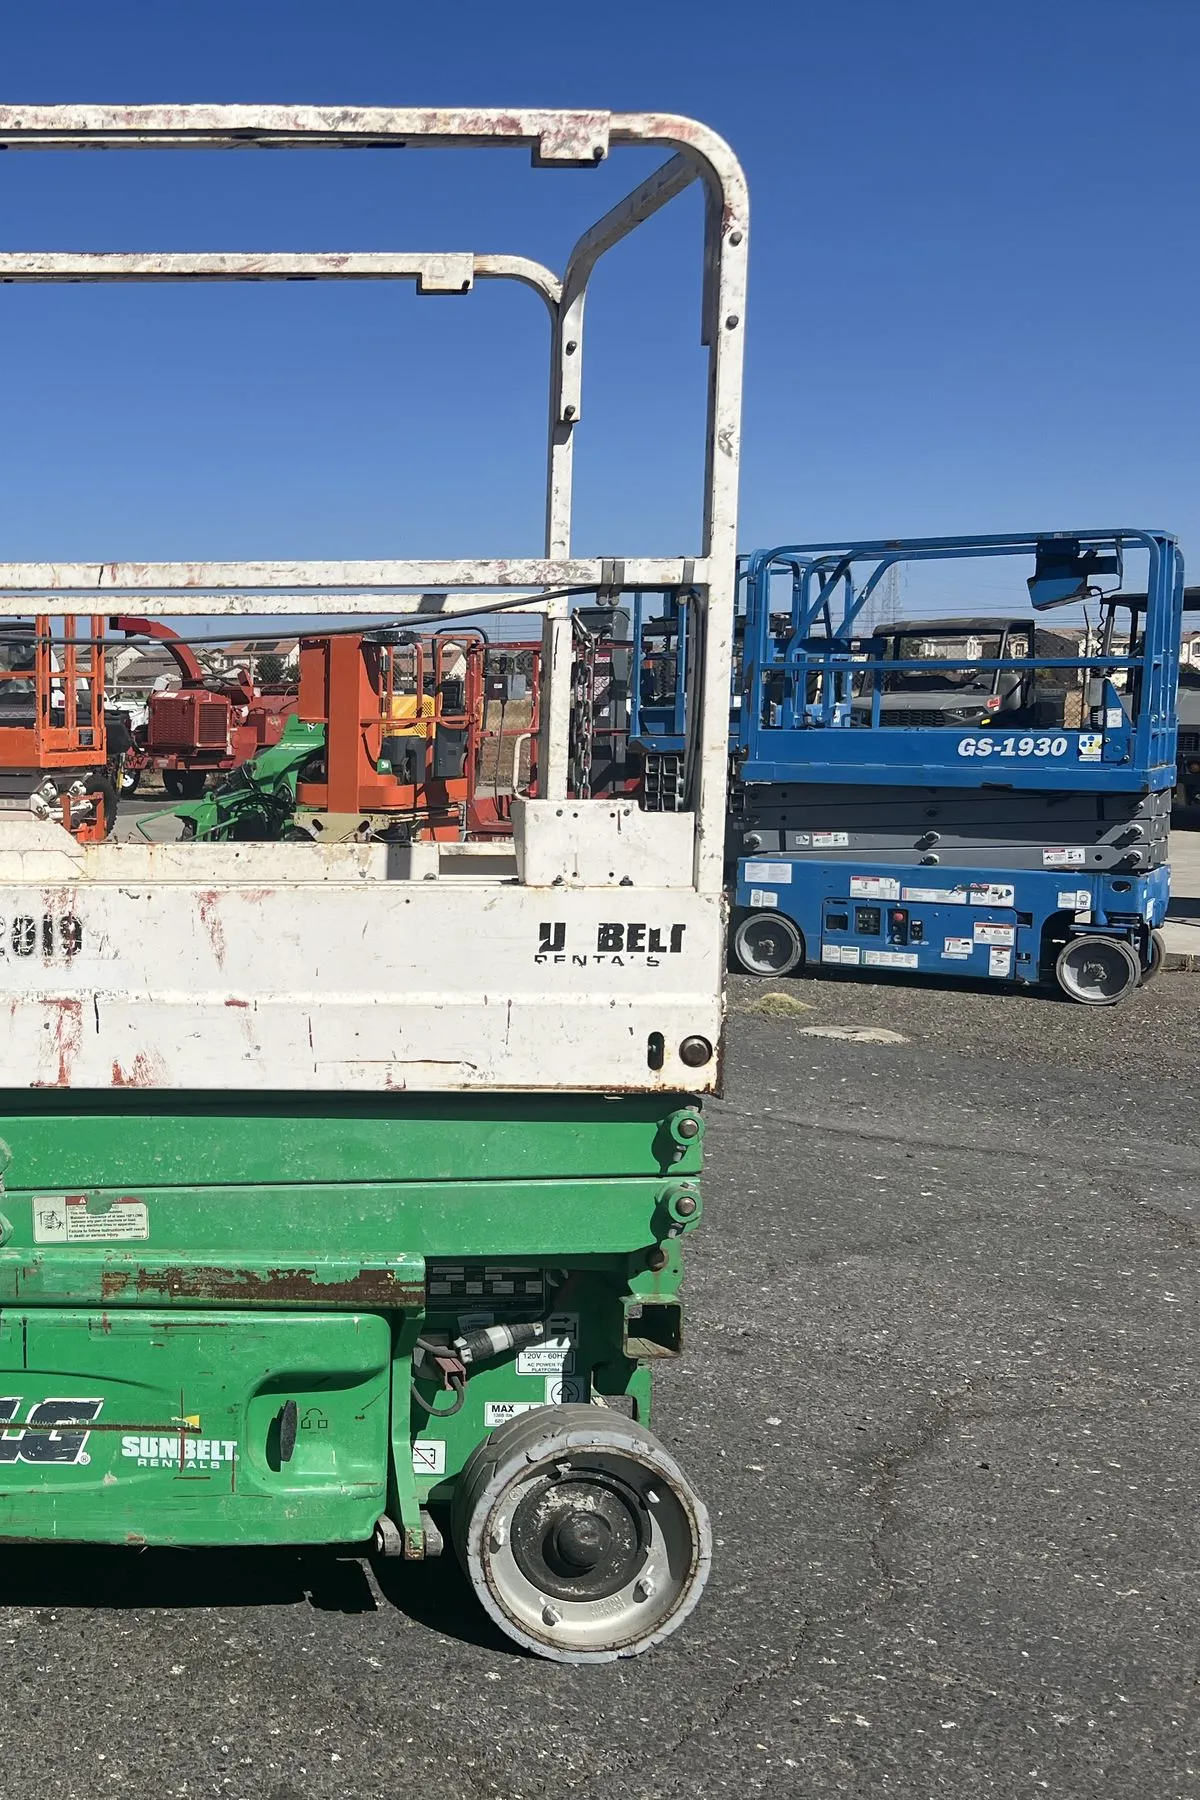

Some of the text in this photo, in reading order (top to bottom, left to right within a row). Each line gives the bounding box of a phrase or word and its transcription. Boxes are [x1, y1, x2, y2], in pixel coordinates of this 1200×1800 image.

[957, 737, 1068, 757] GS-1930
[534, 955, 660, 967] RENTAS
[491, 1405, 515, 1413] MAX
[121, 1436, 238, 1461] SUNBELT
[137, 1458, 221, 1469] RENTALS
